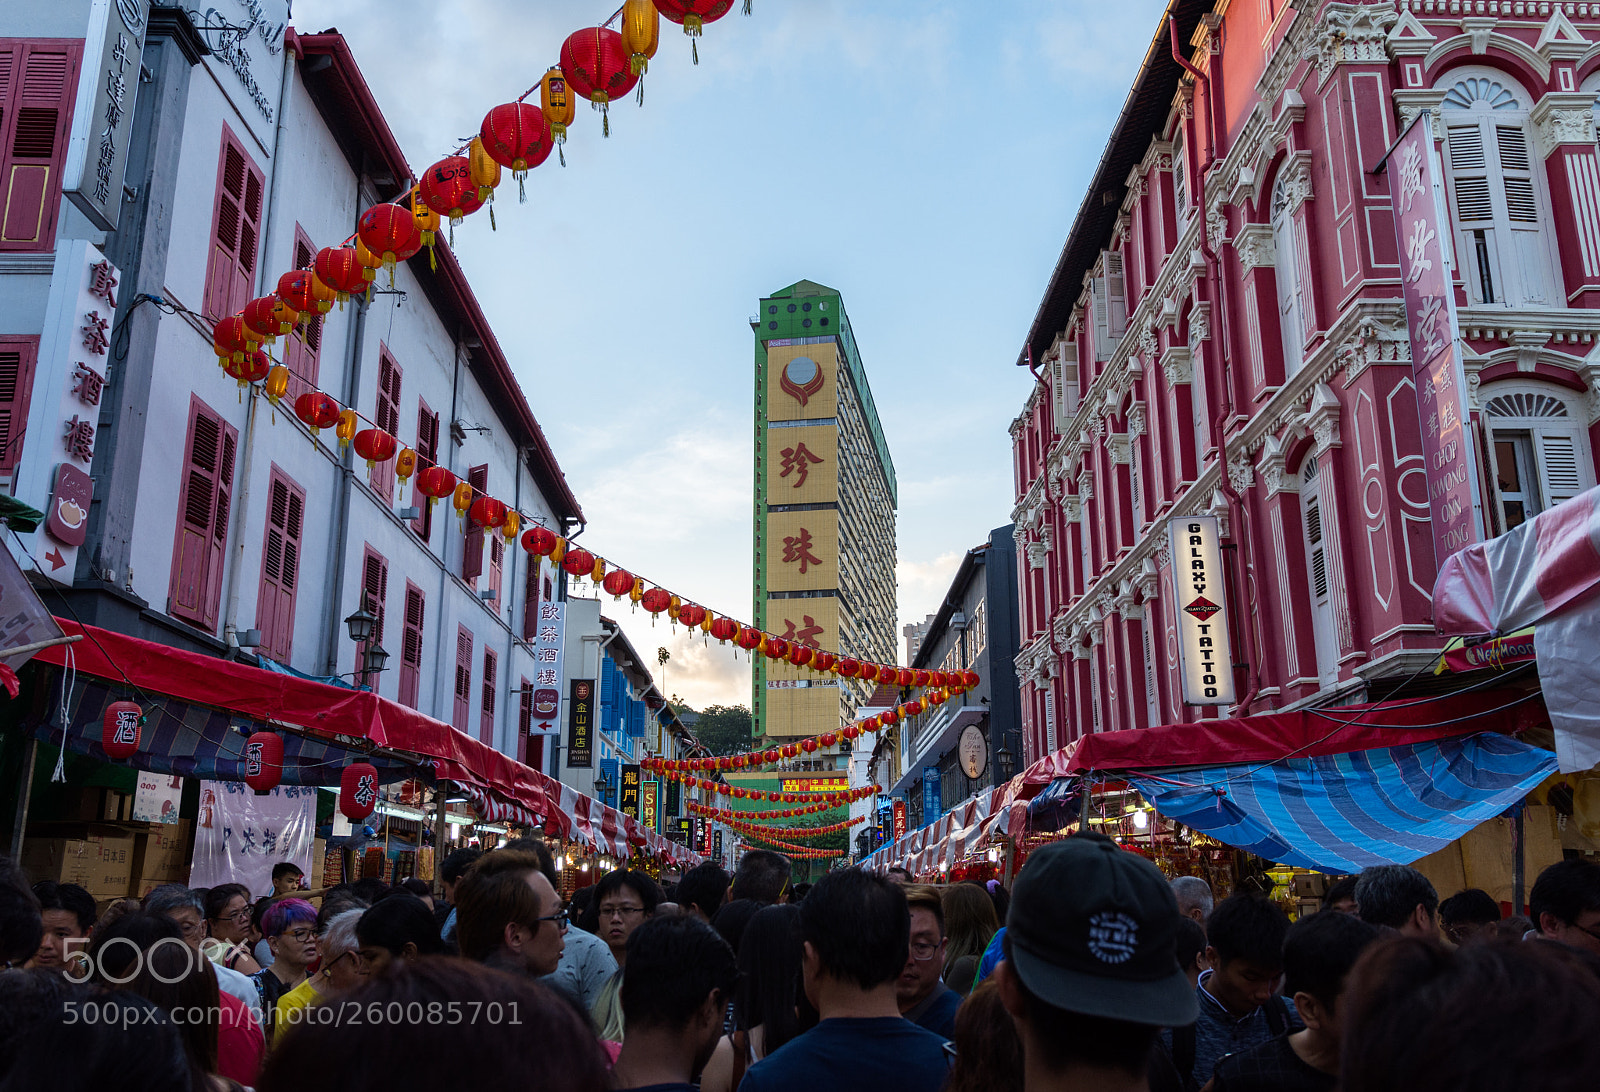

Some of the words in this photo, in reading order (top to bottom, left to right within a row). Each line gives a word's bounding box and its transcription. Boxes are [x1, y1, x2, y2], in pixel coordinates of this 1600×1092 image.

[1398, 140, 1444, 366] 廣安堂
[64, 259, 119, 463] 飲茶酒樓
[1432, 439, 1457, 472] CHOP
[1431, 463, 1467, 501] KWONG
[1441, 495, 1463, 524] ONN
[1441, 522, 1469, 553] TONG
[1187, 523, 1206, 594] GALAXY
[537, 603, 561, 687] 飲茶酒樓
[1197, 624, 1218, 698] TATTOO
[1476, 647, 1499, 663] New
[113, 711, 139, 745] 酒
[575, 702, 587, 748] 金山酒店
[967, 732, 980, 740] The
[965, 740, 981, 749] Inn
[354, 774, 376, 808] 茶
[645, 794, 655, 827] Spa
[103, 848, 126, 863] 日本国
